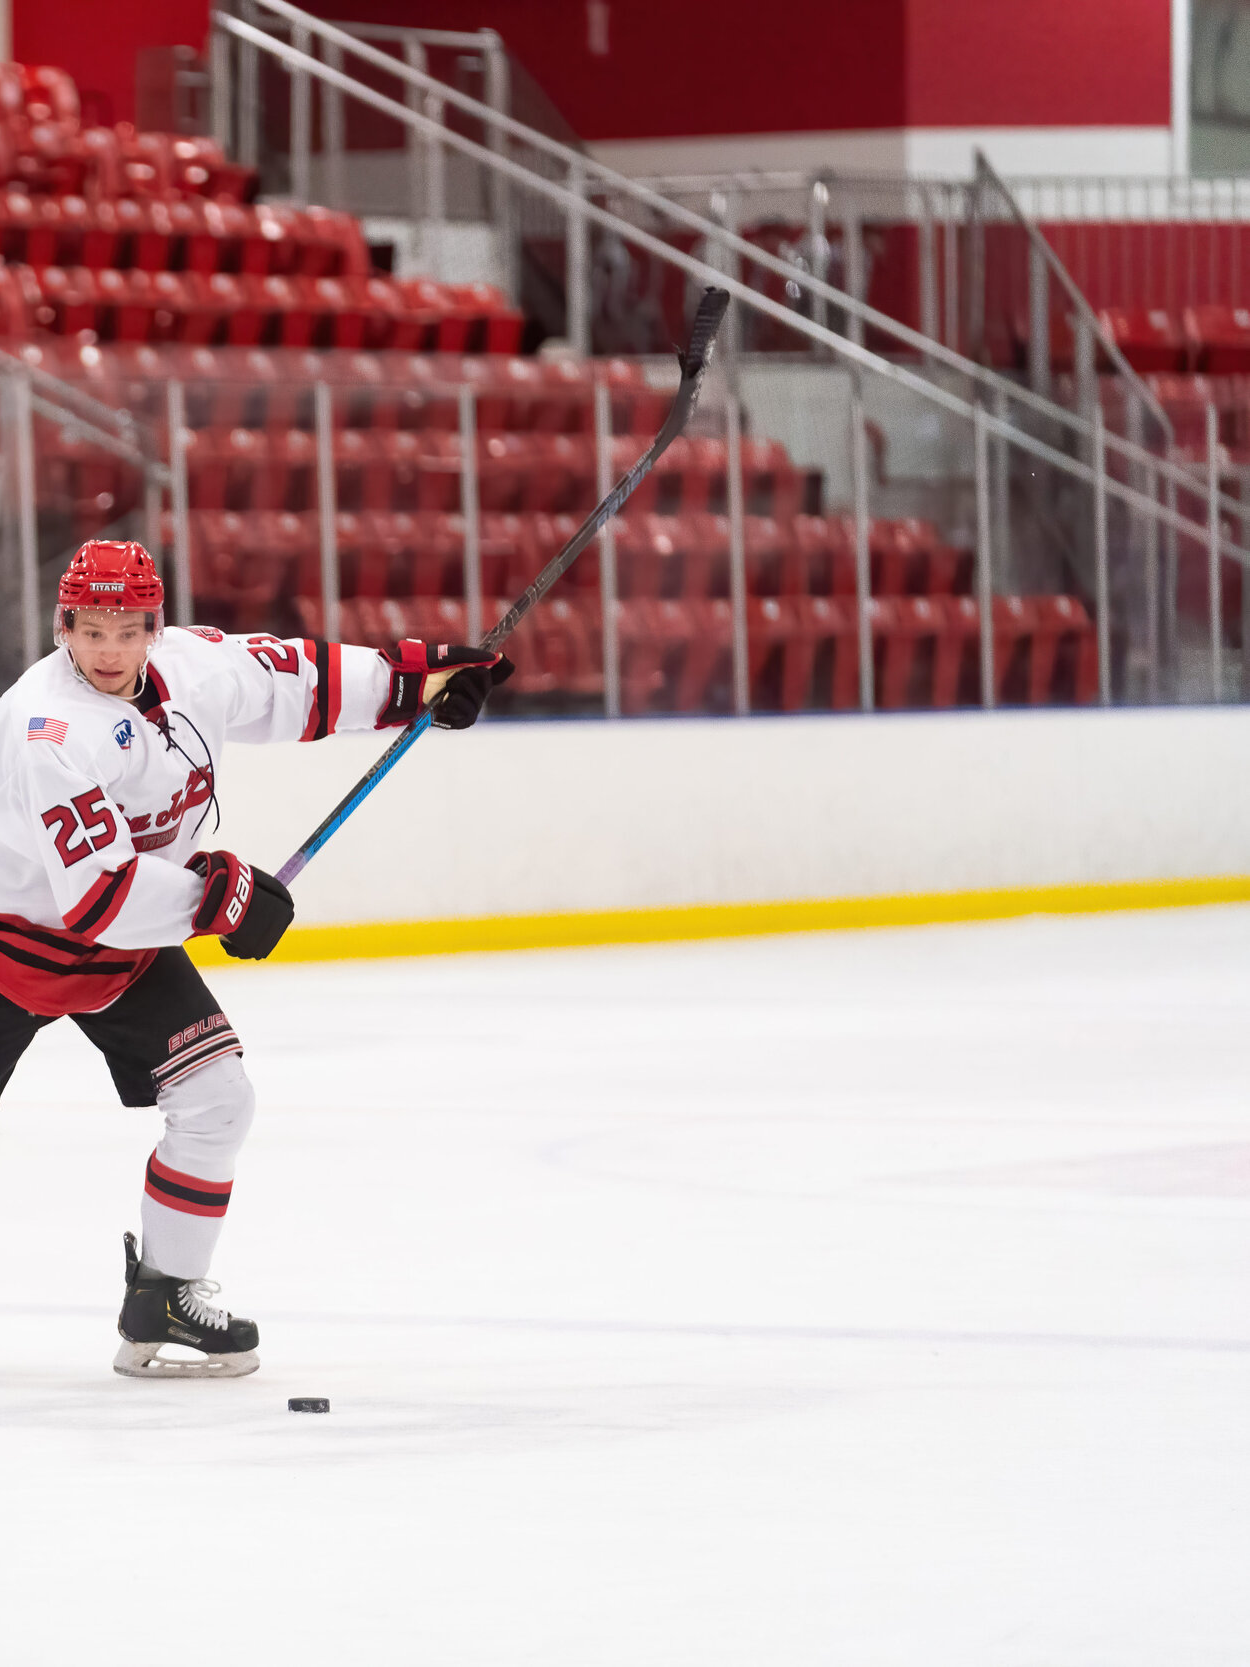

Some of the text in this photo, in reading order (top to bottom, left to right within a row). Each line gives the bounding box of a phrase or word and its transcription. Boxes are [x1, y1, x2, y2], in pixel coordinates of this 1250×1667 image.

[89, 582, 125, 592] TITANS
[365, 731, 410, 780] NEXUS
[41, 785, 118, 869] 25
[225, 860, 252, 926] BAU
